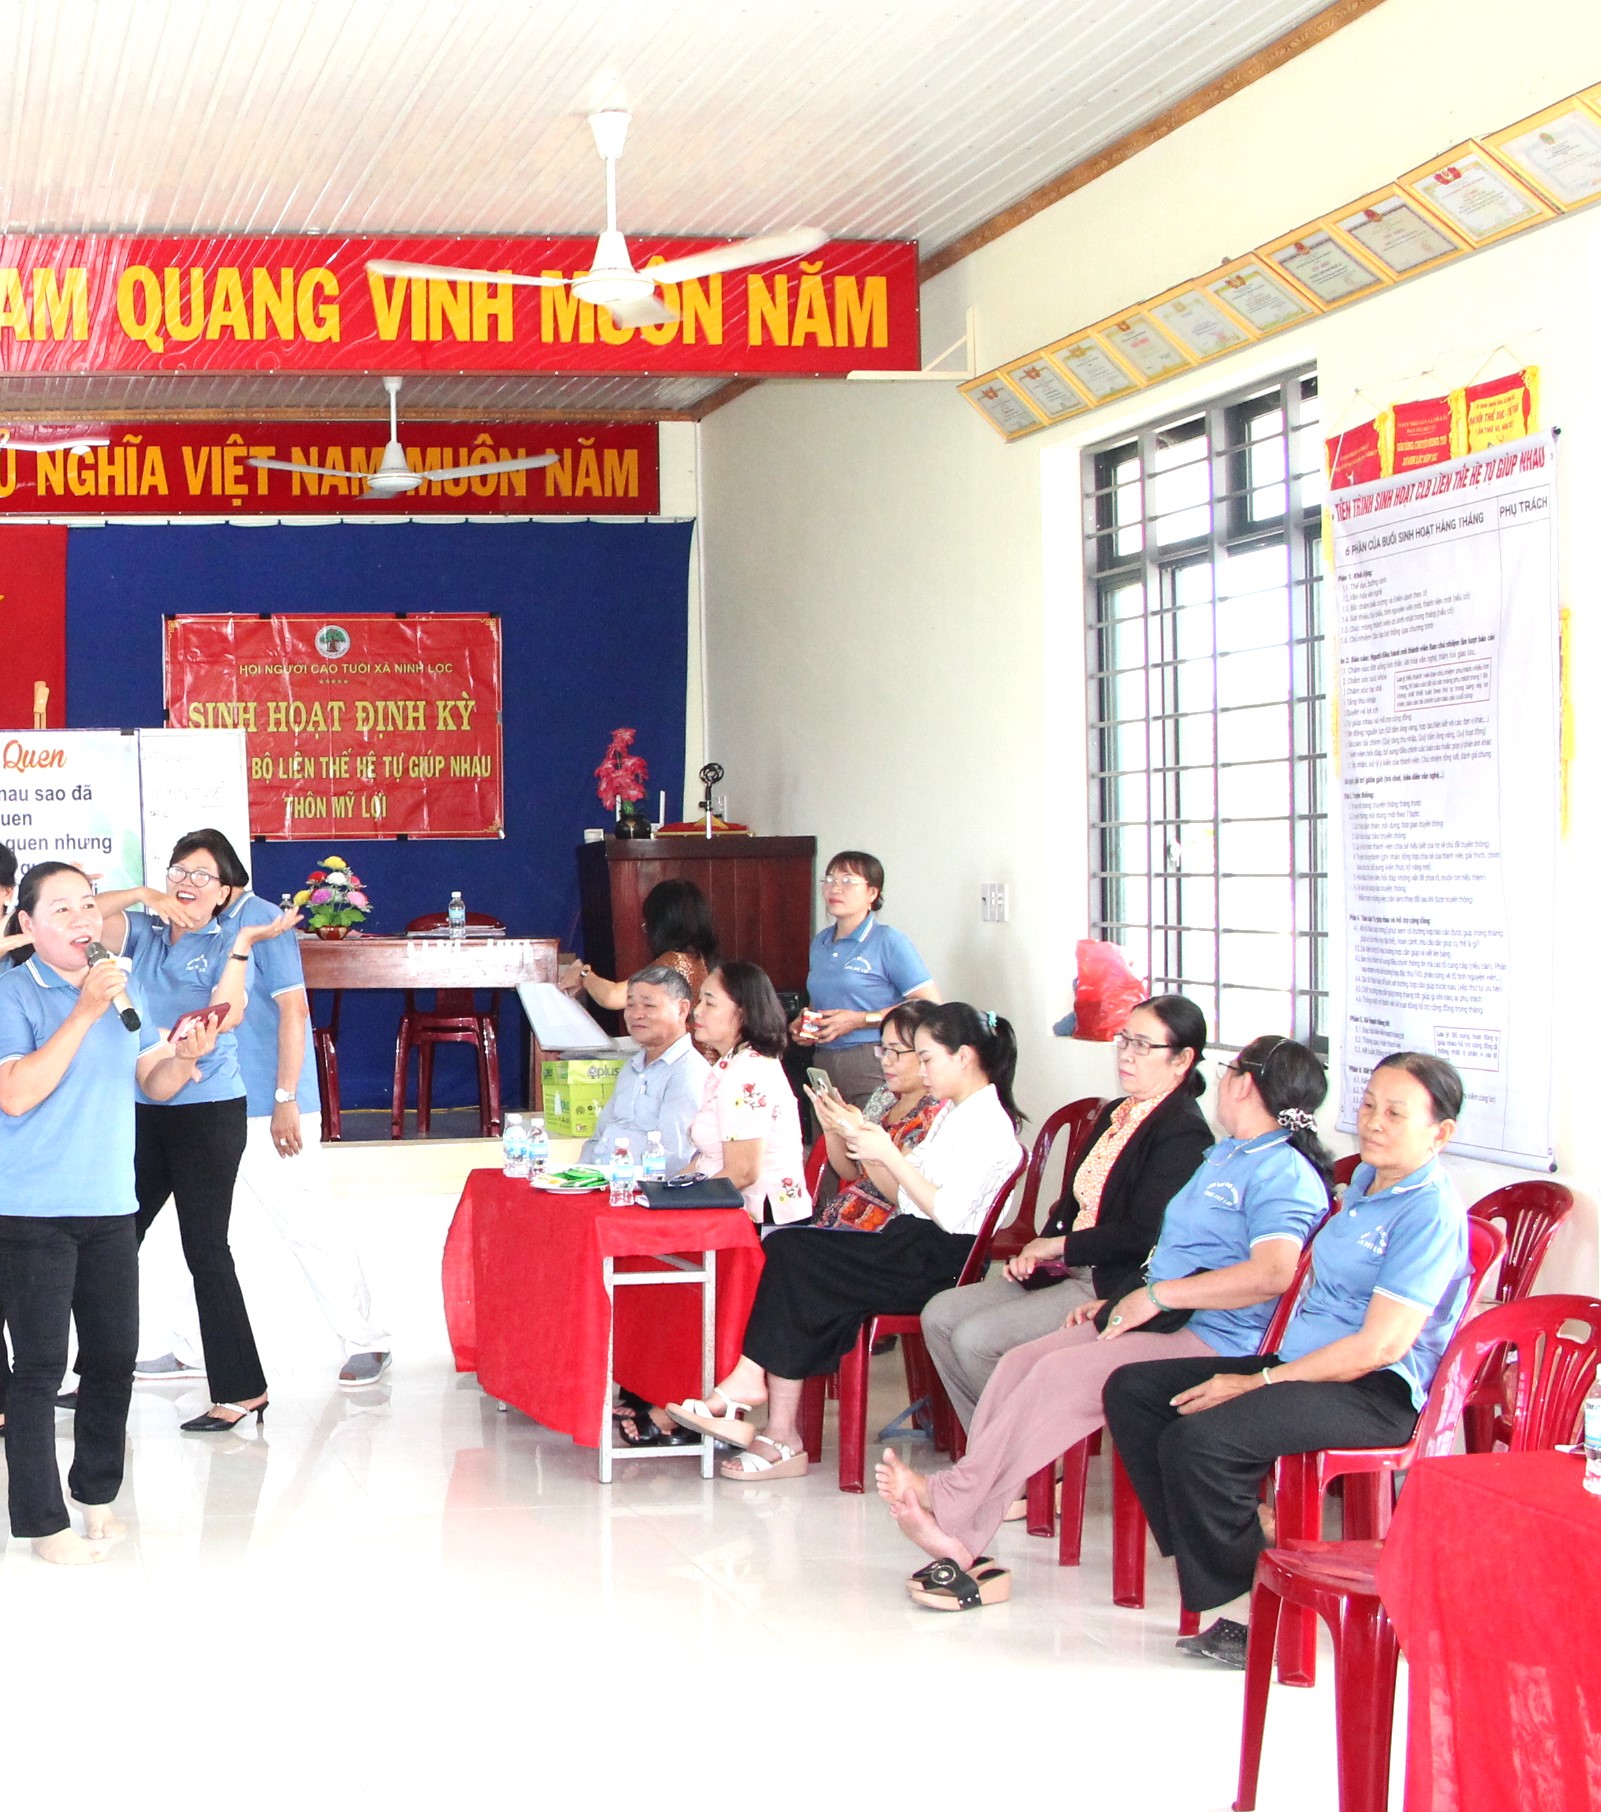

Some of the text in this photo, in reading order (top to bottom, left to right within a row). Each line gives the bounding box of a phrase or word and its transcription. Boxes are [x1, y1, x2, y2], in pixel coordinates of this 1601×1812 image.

[116, 264, 340, 353] QUANG
[367, 266, 513, 342] VINH
[747, 260, 888, 348] NĂM
[37, 434, 168, 497] NGHĨA
[182, 433, 276, 506] VIỆT
[291, 446, 381, 496] NAM
[406, 433, 526, 497] MUÔN
[546, 436, 638, 497] NĂM
[1374, 494, 1392, 514] SINH
[1394, 490, 1414, 508] HOẠT
[1415, 480, 1431, 499] CLB
[1519, 446, 1545, 472] NHAU
[1499, 495, 1548, 519] PHỤ TRÁCH
[1398, 530, 1414, 545] SINH
[1415, 524, 1434, 541] HOẠT
[1435, 518, 1457, 534] HÀNG
[1458, 512, 1485, 529] THÁNG
[310, 664, 338, 674] CAO
[375, 662, 390, 673] XÃ
[394, 663, 423, 673] NINH
[188, 691, 476, 739] SINH HOẠT ĐỊNH KỲ
[2, 740, 67, 769] Quen
[252, 748, 491, 783] BỘ LIÊN THẾ HỆ TỰ GIÚP NHAU
[34, 789, 65, 801] sao
[71, 784, 92, 801] đã
[284, 791, 326, 818] THÔN
[332, 790, 355, 817] MỸ
[55, 833, 112, 853] nhưng
